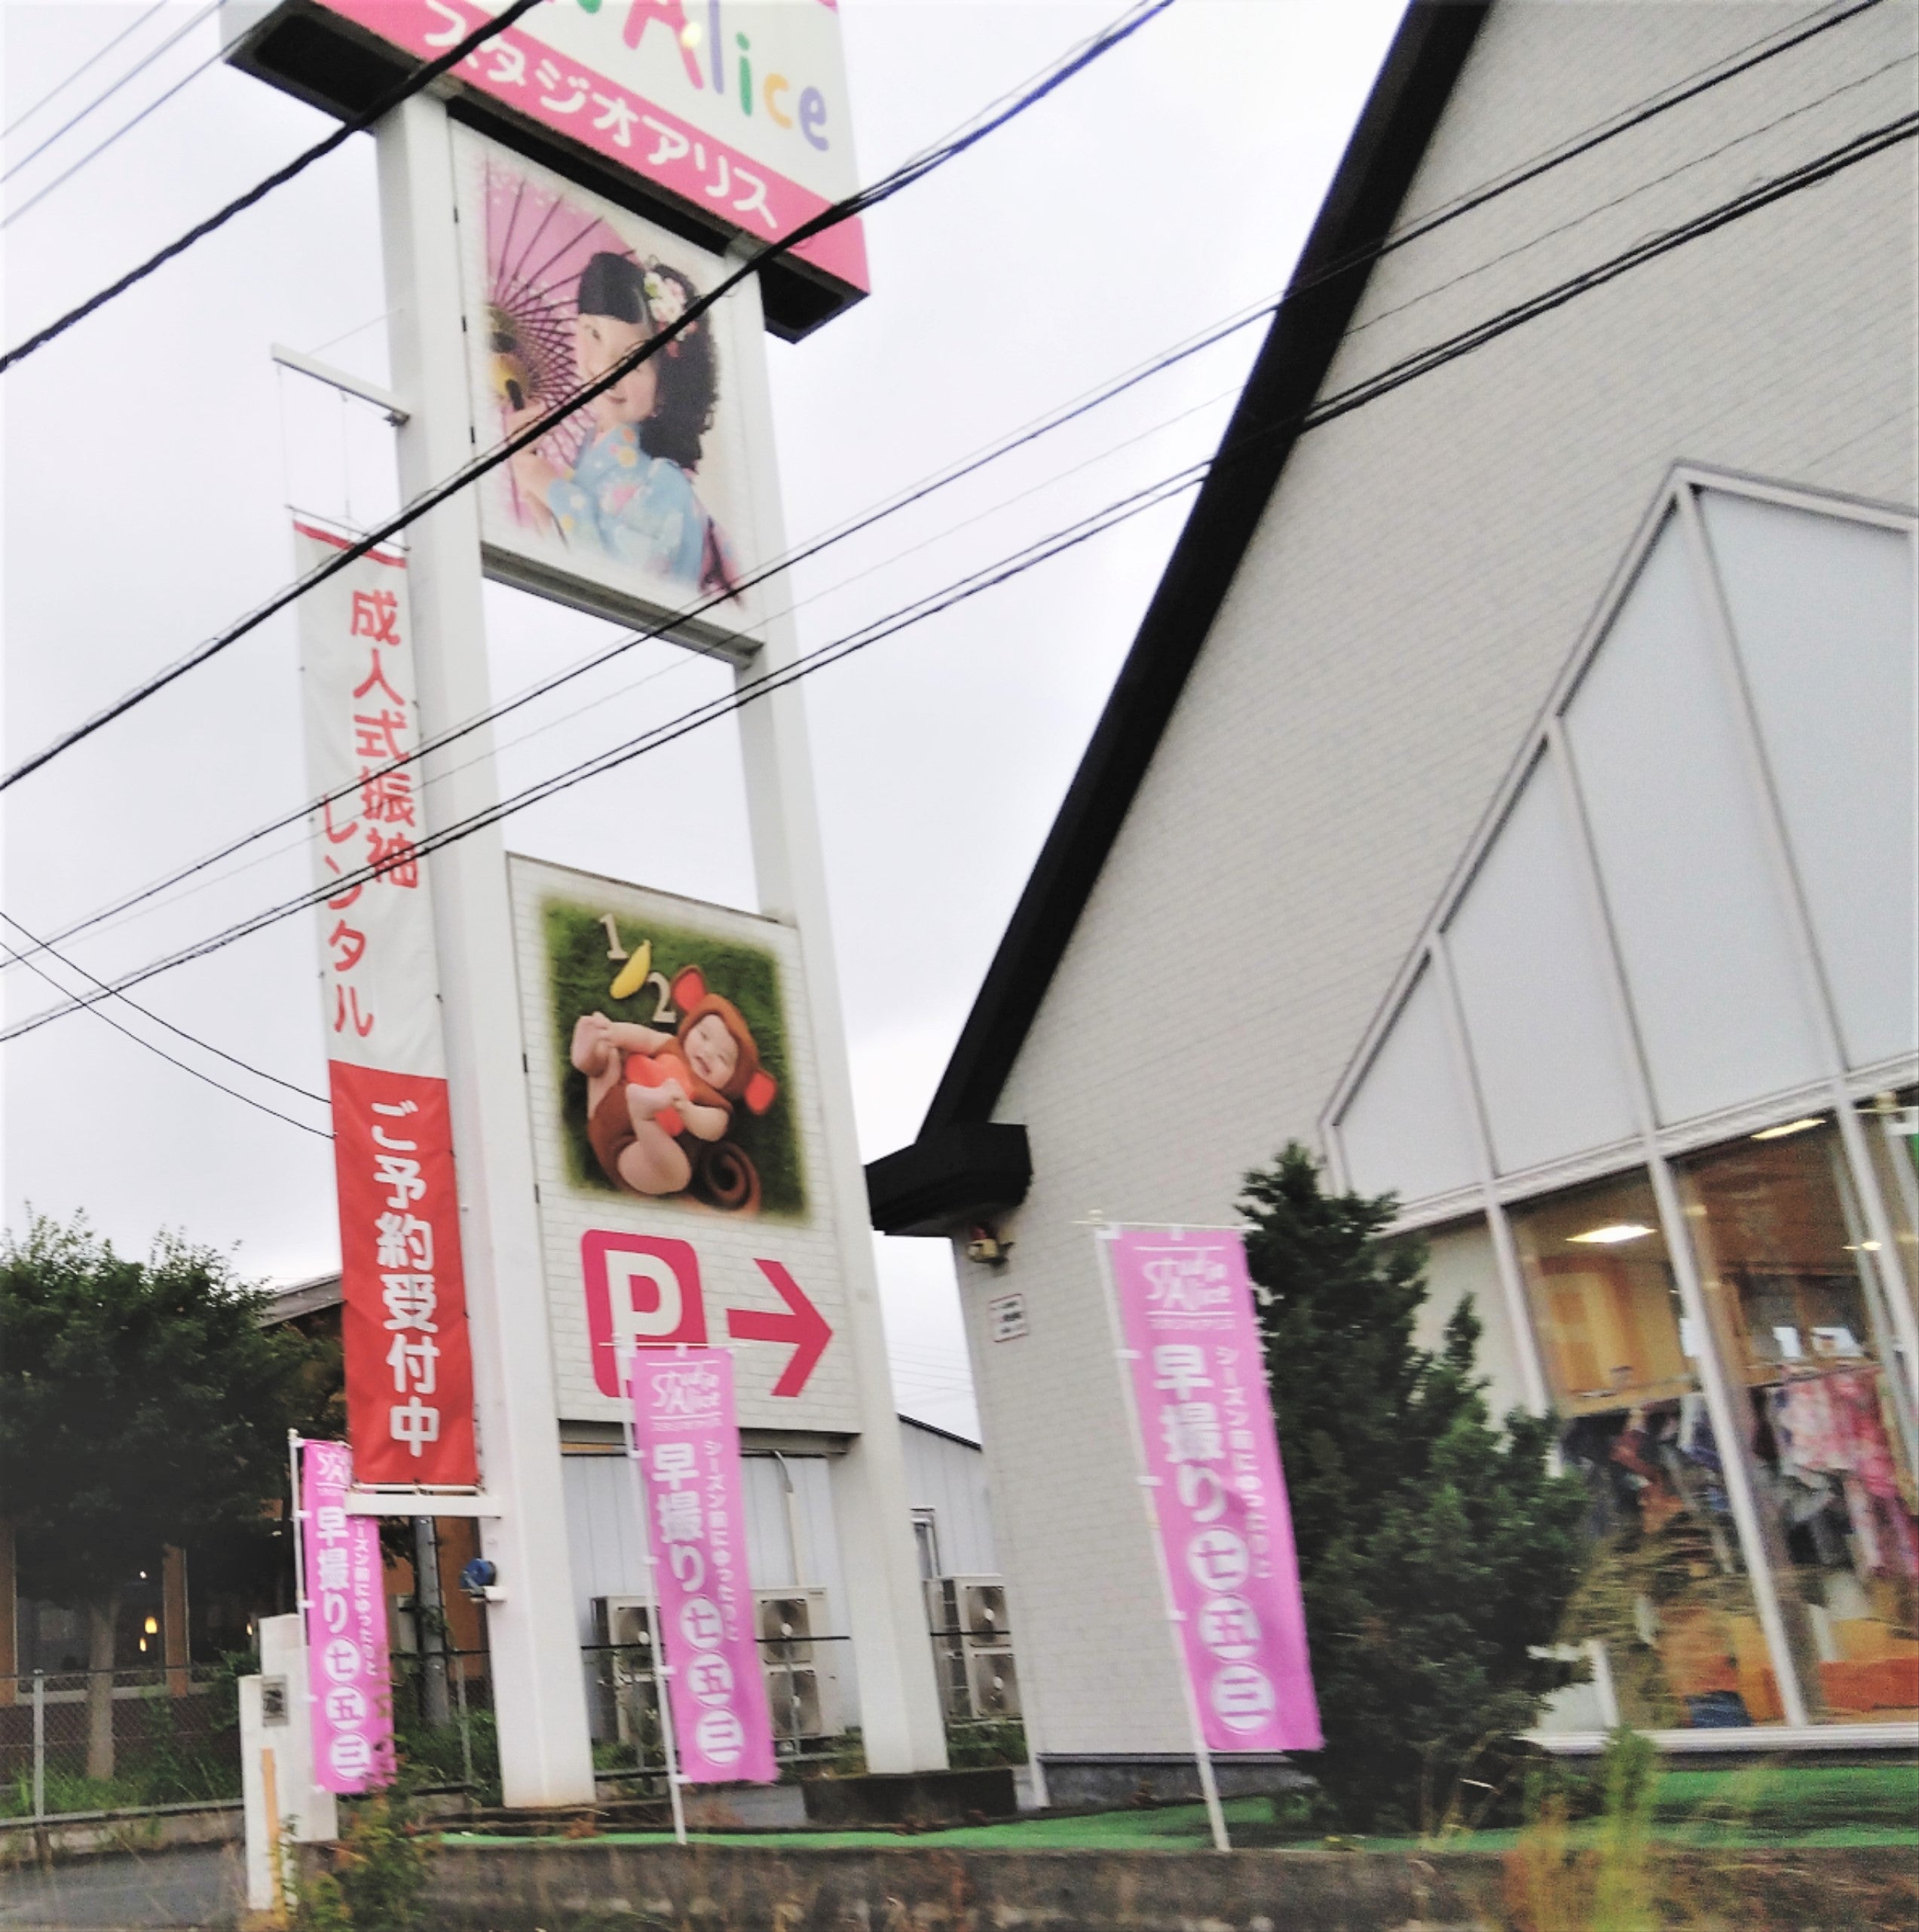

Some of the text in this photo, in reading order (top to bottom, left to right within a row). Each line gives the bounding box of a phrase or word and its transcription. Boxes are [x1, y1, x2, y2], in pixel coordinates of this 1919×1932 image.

[424, 0, 778, 228] スタジオアリス
[350, 589, 419, 889] 成人式振袖
[322, 793, 374, 1037] レンタル
[371, 1099, 441, 1459] ご予約受付中
[604, 1248, 683, 1376] P
